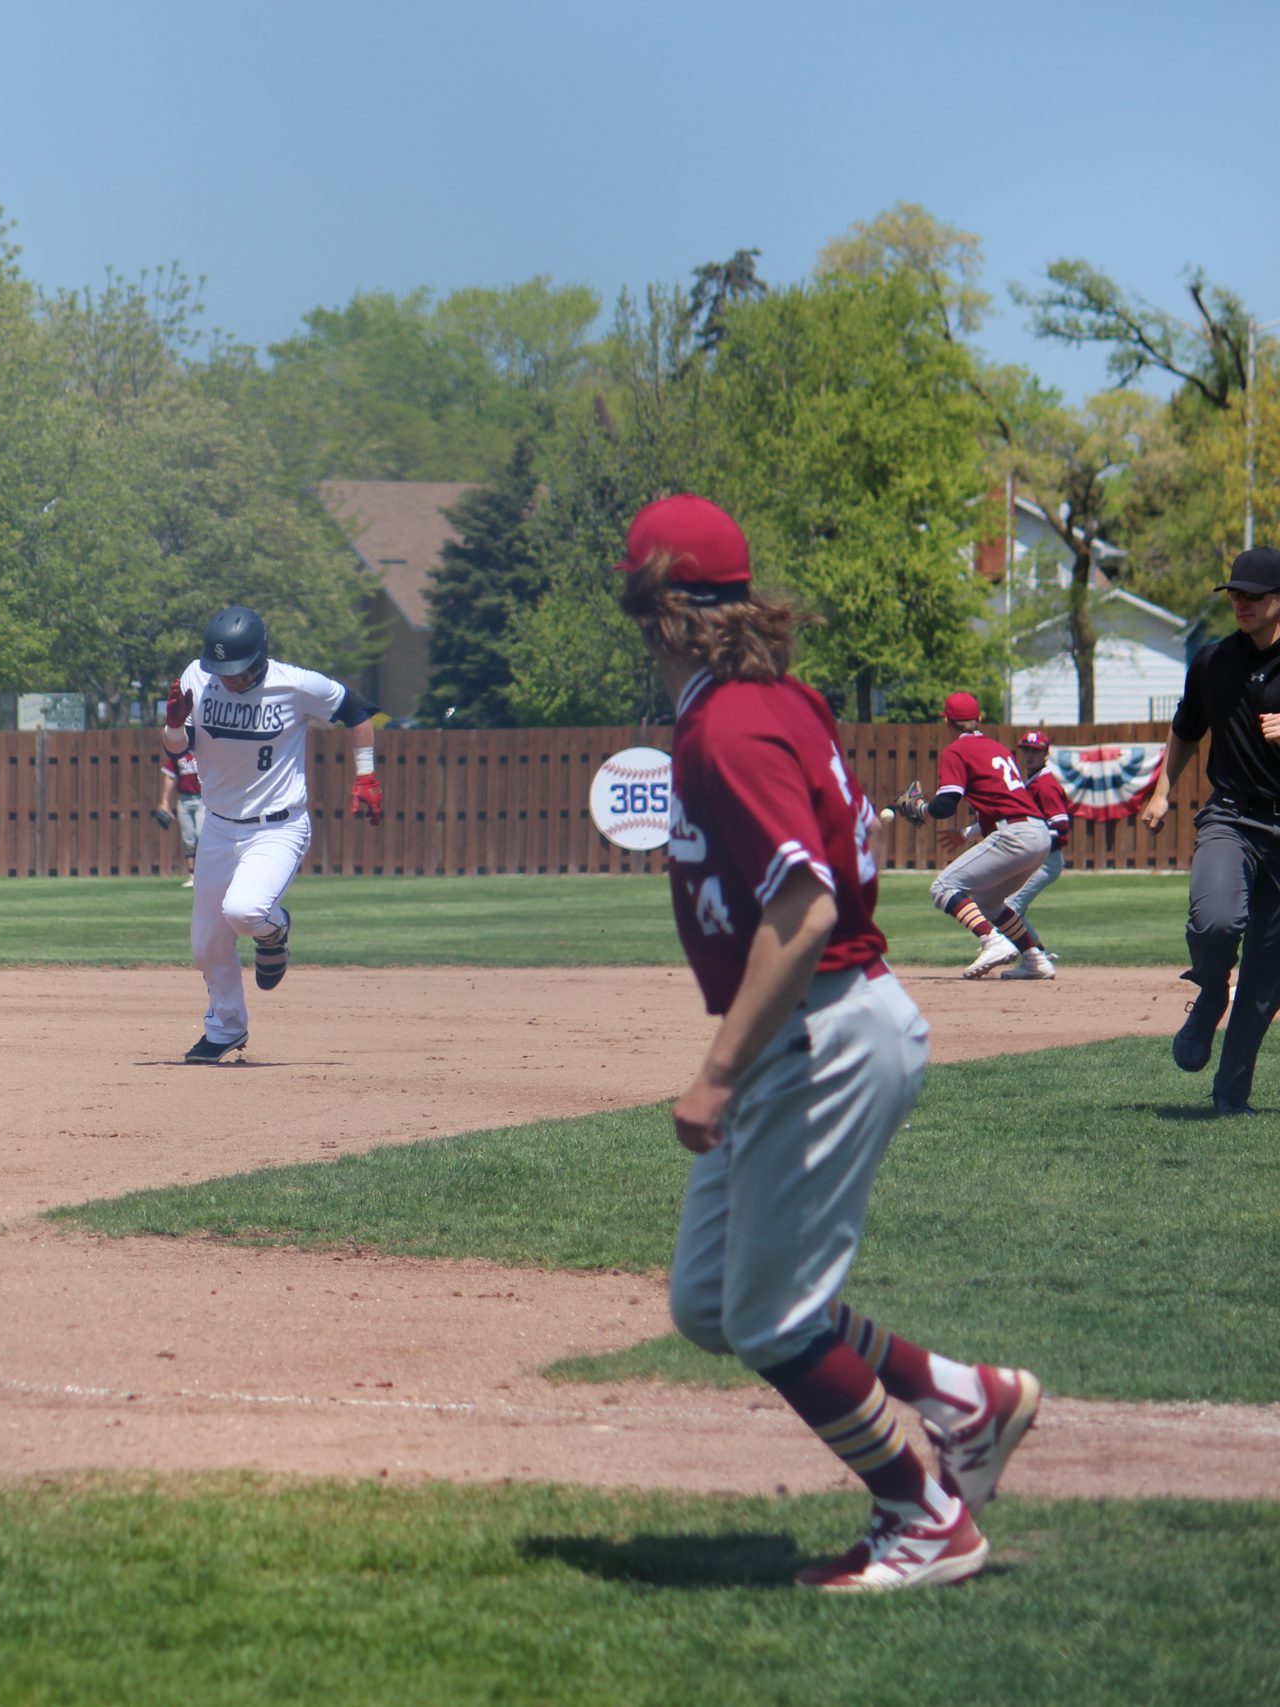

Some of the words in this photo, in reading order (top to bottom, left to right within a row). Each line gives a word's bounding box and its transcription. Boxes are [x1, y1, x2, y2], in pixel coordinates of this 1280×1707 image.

[202, 697, 284, 731] BULLDOGS
[257, 745, 274, 771] 8
[610, 783, 669, 813] 365
